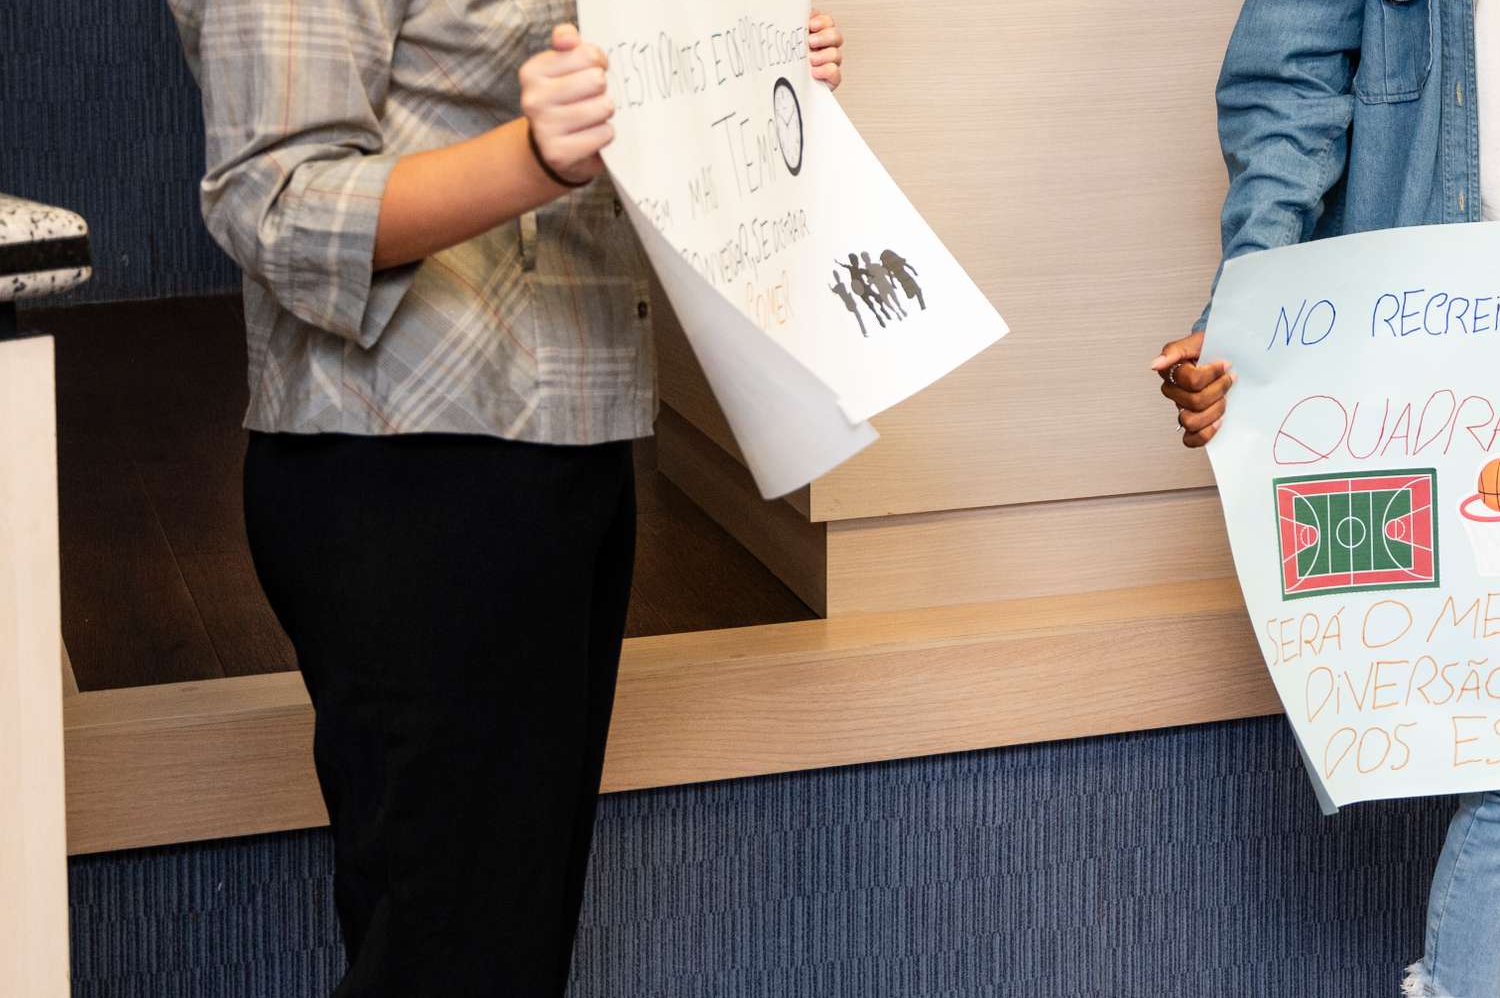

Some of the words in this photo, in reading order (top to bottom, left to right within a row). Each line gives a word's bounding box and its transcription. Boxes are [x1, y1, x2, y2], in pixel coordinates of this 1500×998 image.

[1268, 299, 1337, 350] NO
[1266, 604, 1342, 667] SERÁ
[1362, 601, 1413, 649] O
[1323, 722, 1419, 781] DOS
